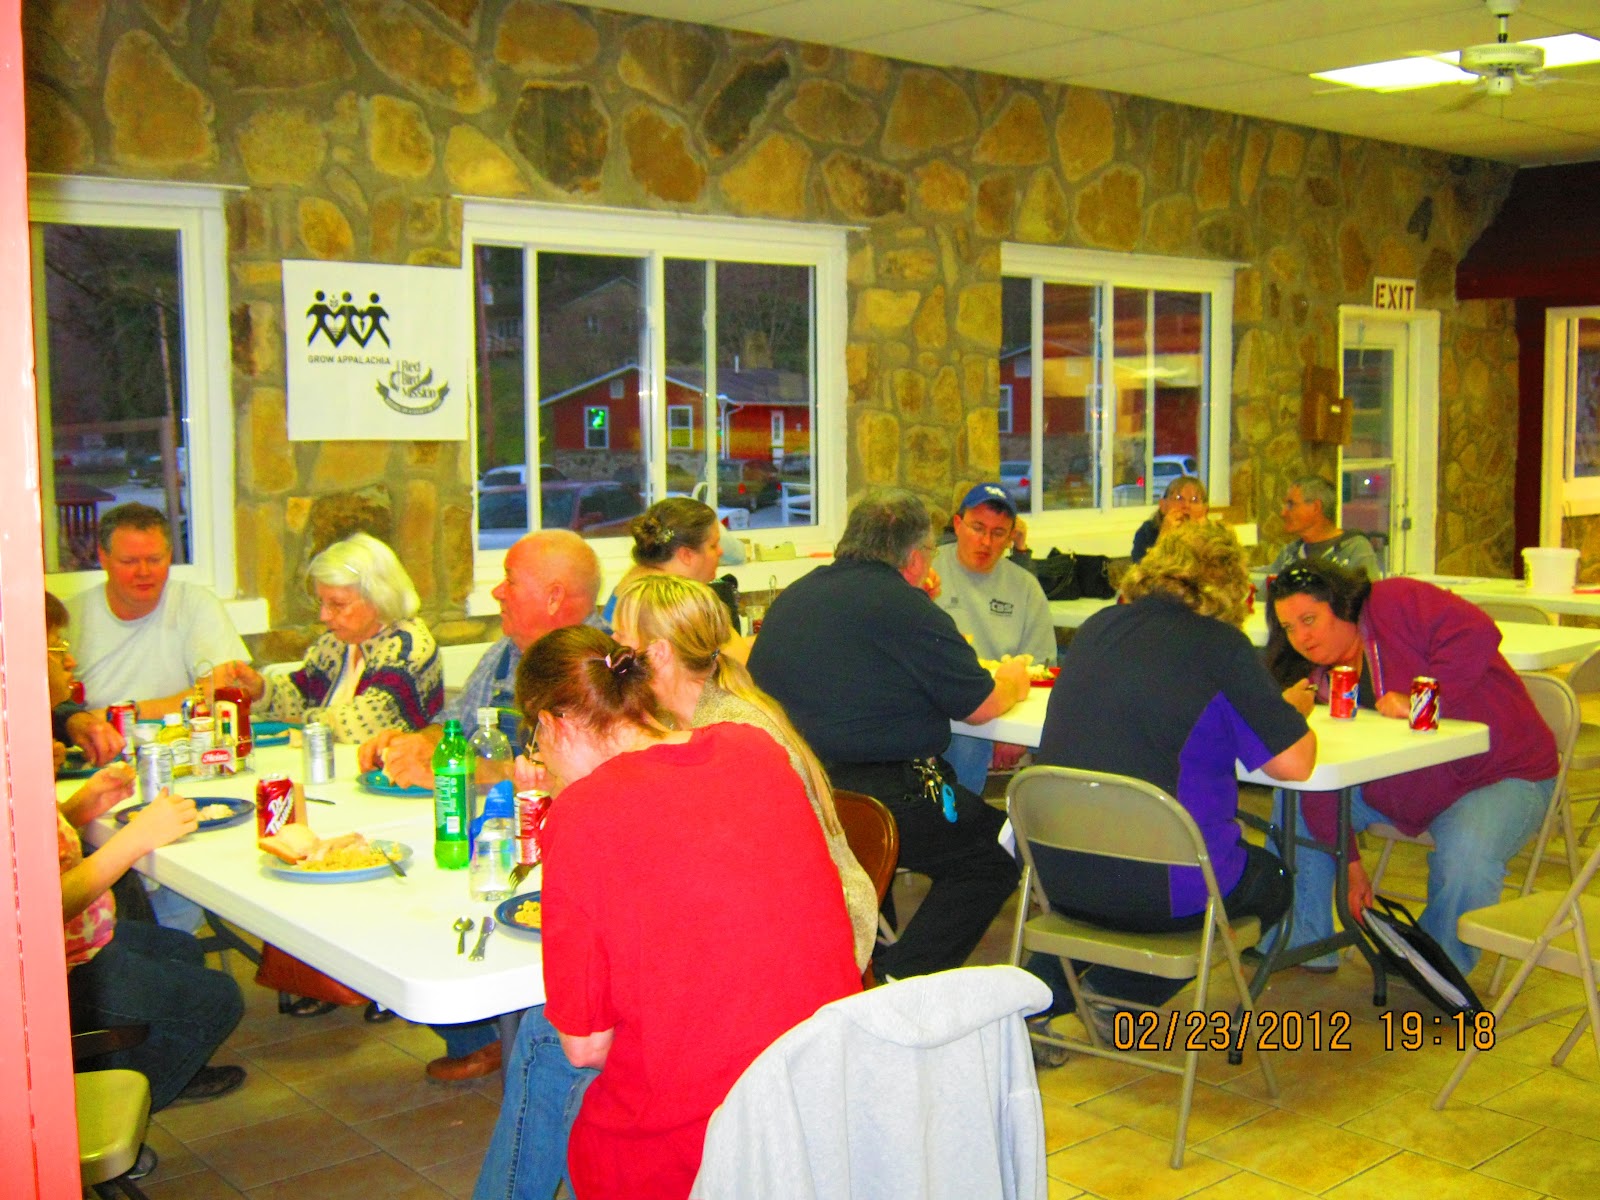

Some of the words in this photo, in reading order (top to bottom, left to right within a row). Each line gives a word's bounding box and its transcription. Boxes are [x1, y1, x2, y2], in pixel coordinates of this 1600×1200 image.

[1376, 284, 1414, 311] EXIT
[307, 355, 334, 363] GROW
[337, 356, 390, 364] APPALACHIA
[402, 360, 420, 372] Red
